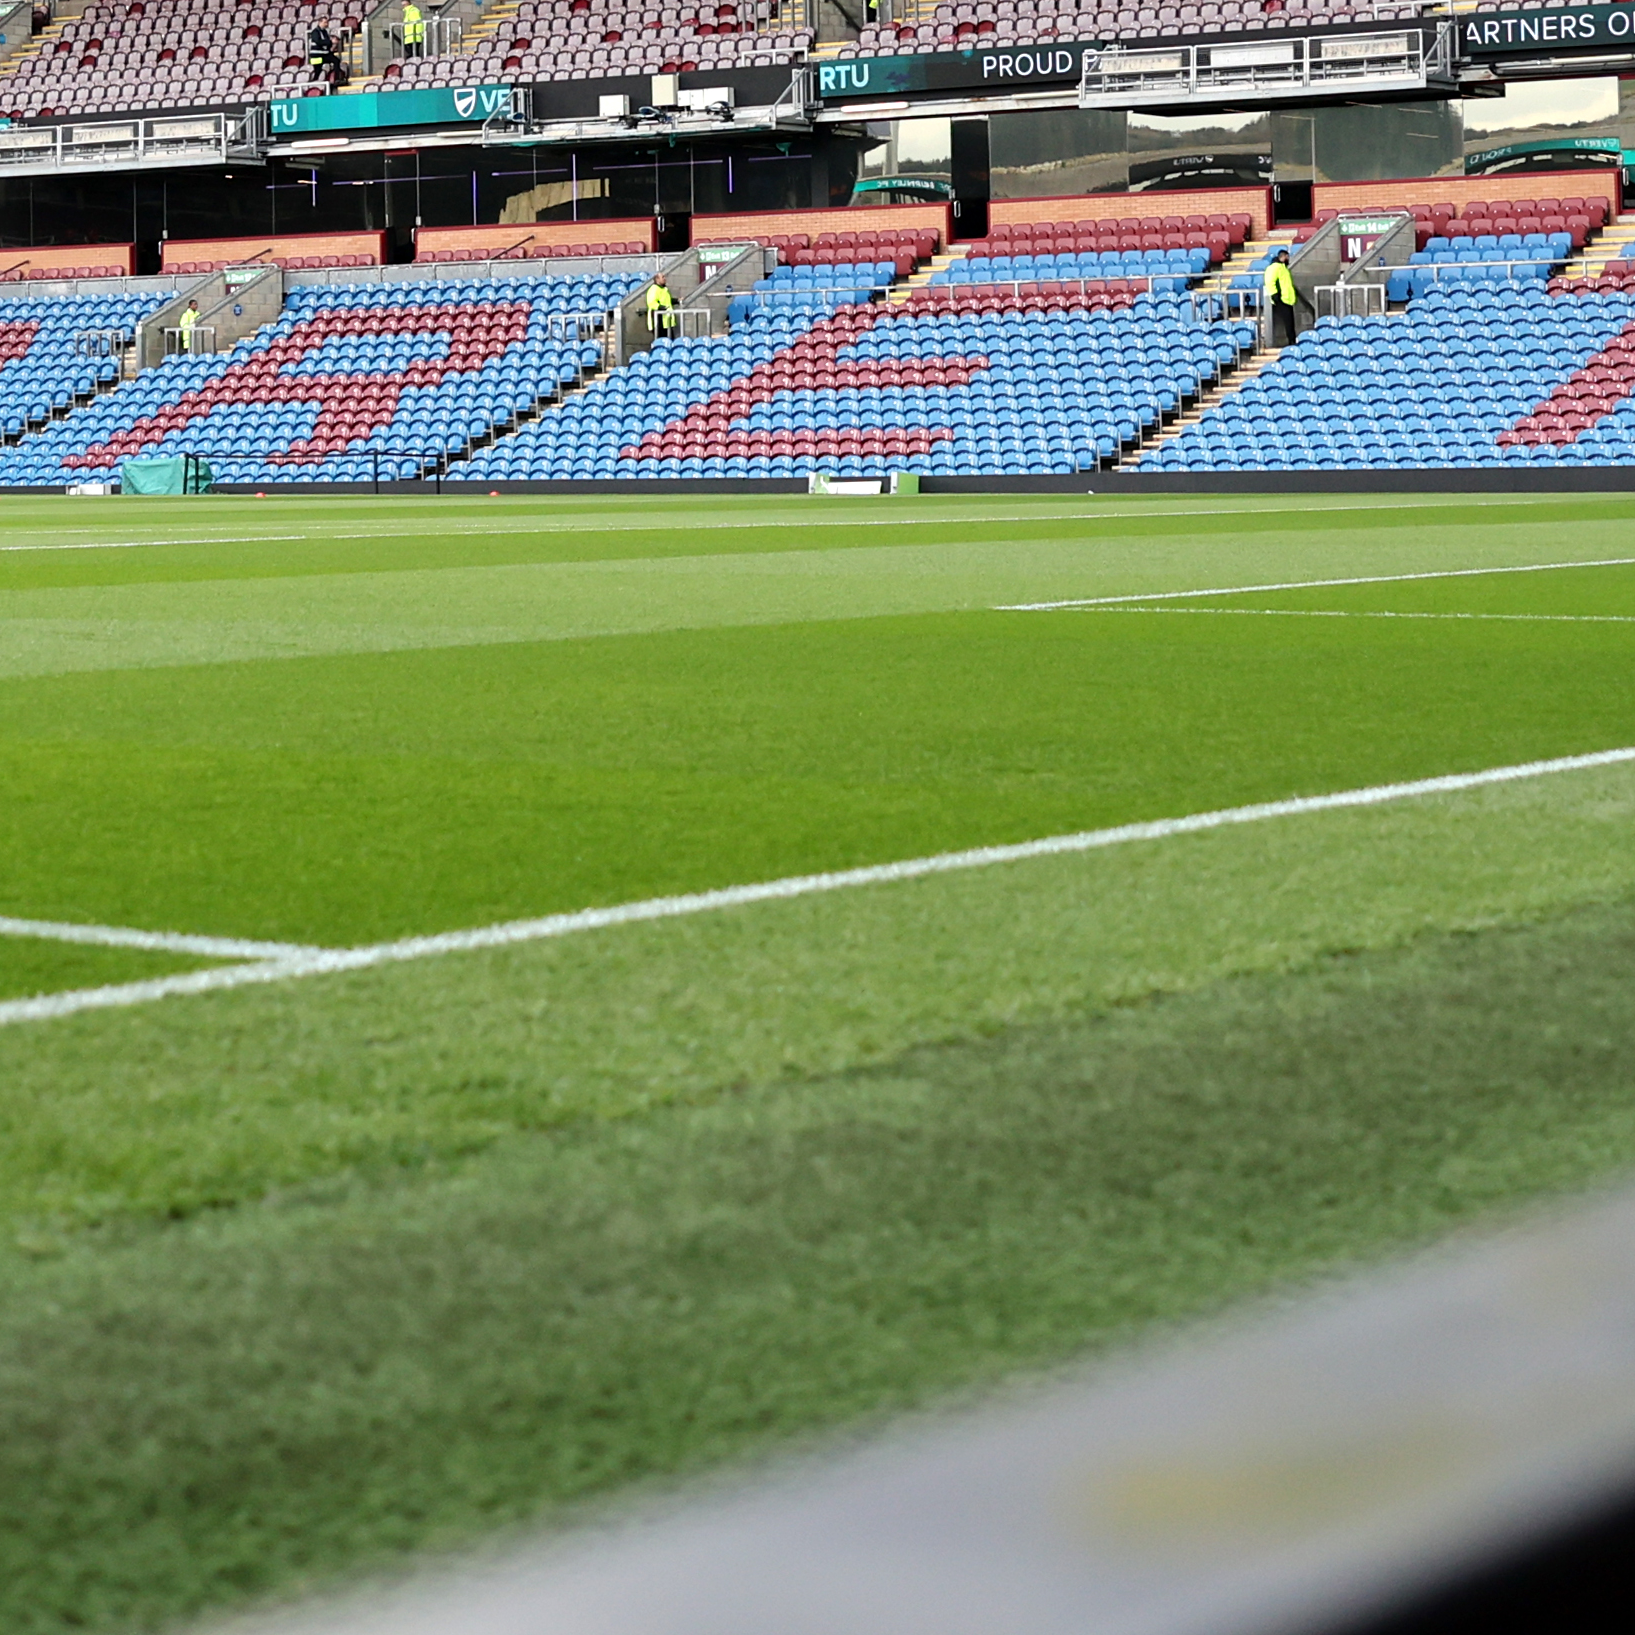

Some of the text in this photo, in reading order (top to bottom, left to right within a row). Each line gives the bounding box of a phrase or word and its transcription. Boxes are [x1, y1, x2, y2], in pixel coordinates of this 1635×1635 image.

[983, 50, 1073, 78] PROUD
[820, 63, 869, 91] RTU
[270, 104, 298, 126] TU
[1347, 238, 1361, 258] N
